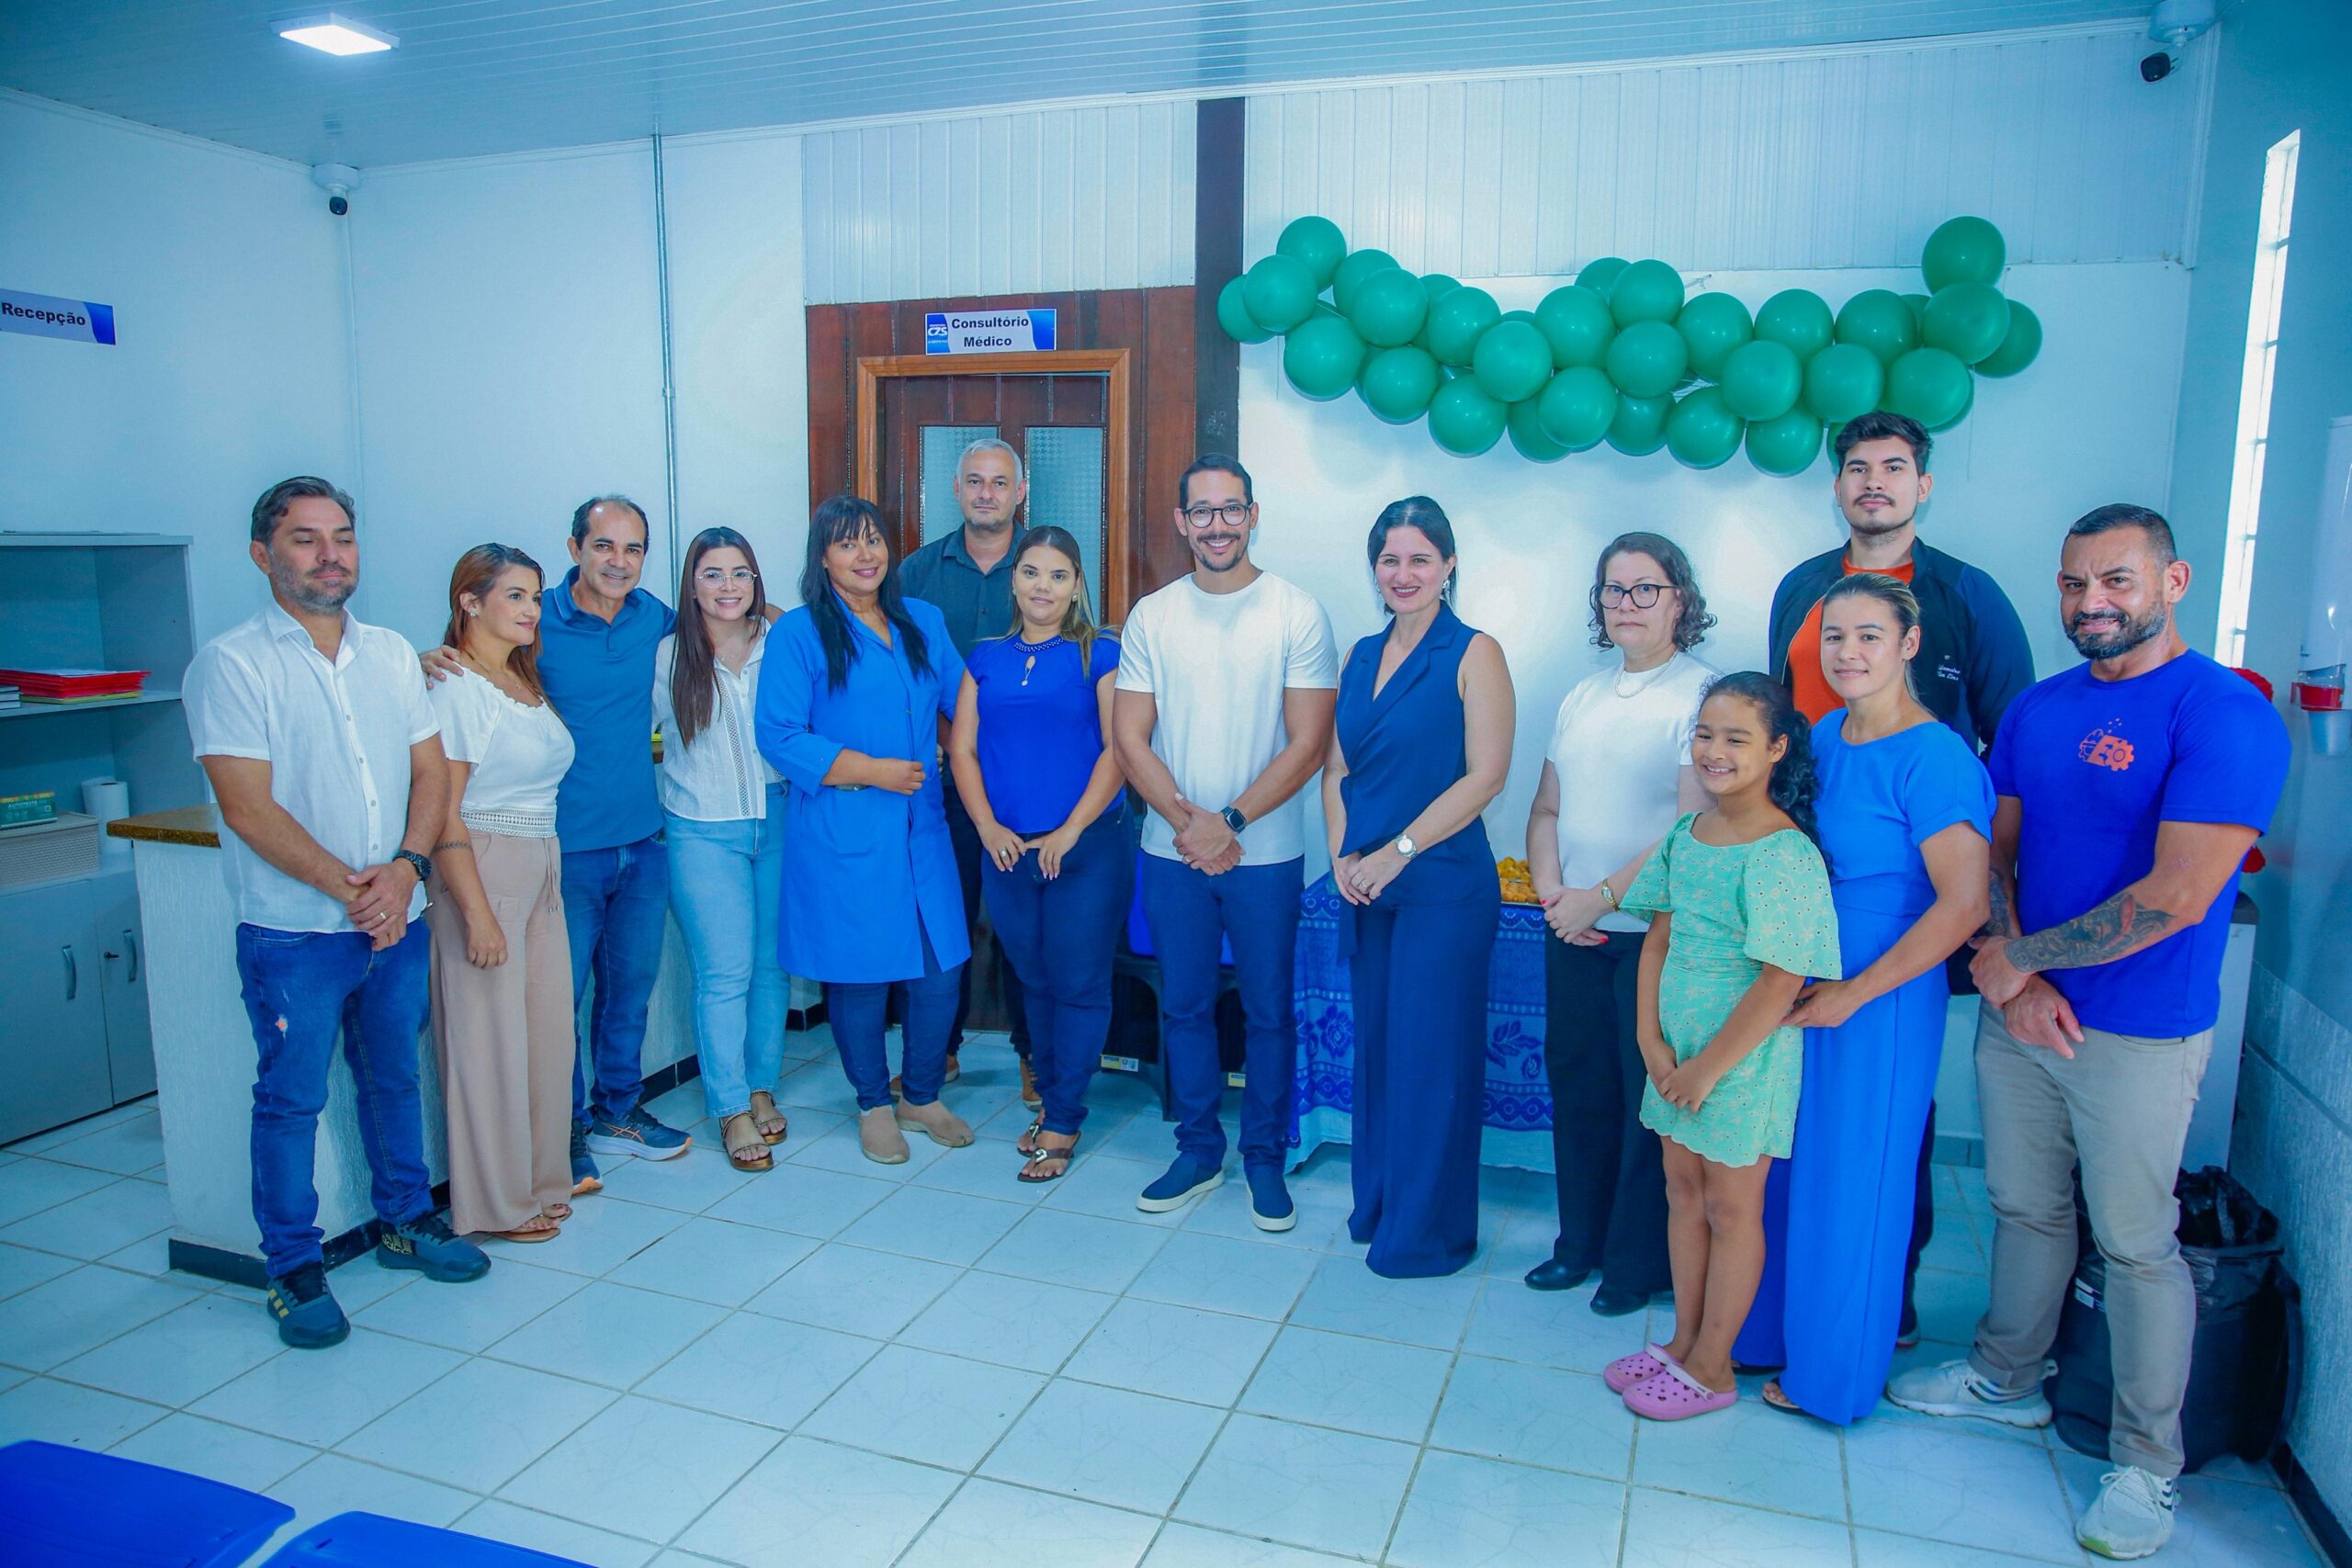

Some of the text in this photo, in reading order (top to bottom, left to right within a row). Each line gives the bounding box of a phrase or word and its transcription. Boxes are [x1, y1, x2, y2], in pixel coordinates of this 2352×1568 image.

[1, 301, 86, 326] Recepção
[951, 316, 1029, 329] Consultório
[927, 326, 948, 336] CZS
[964, 336, 1012, 347] Médico
